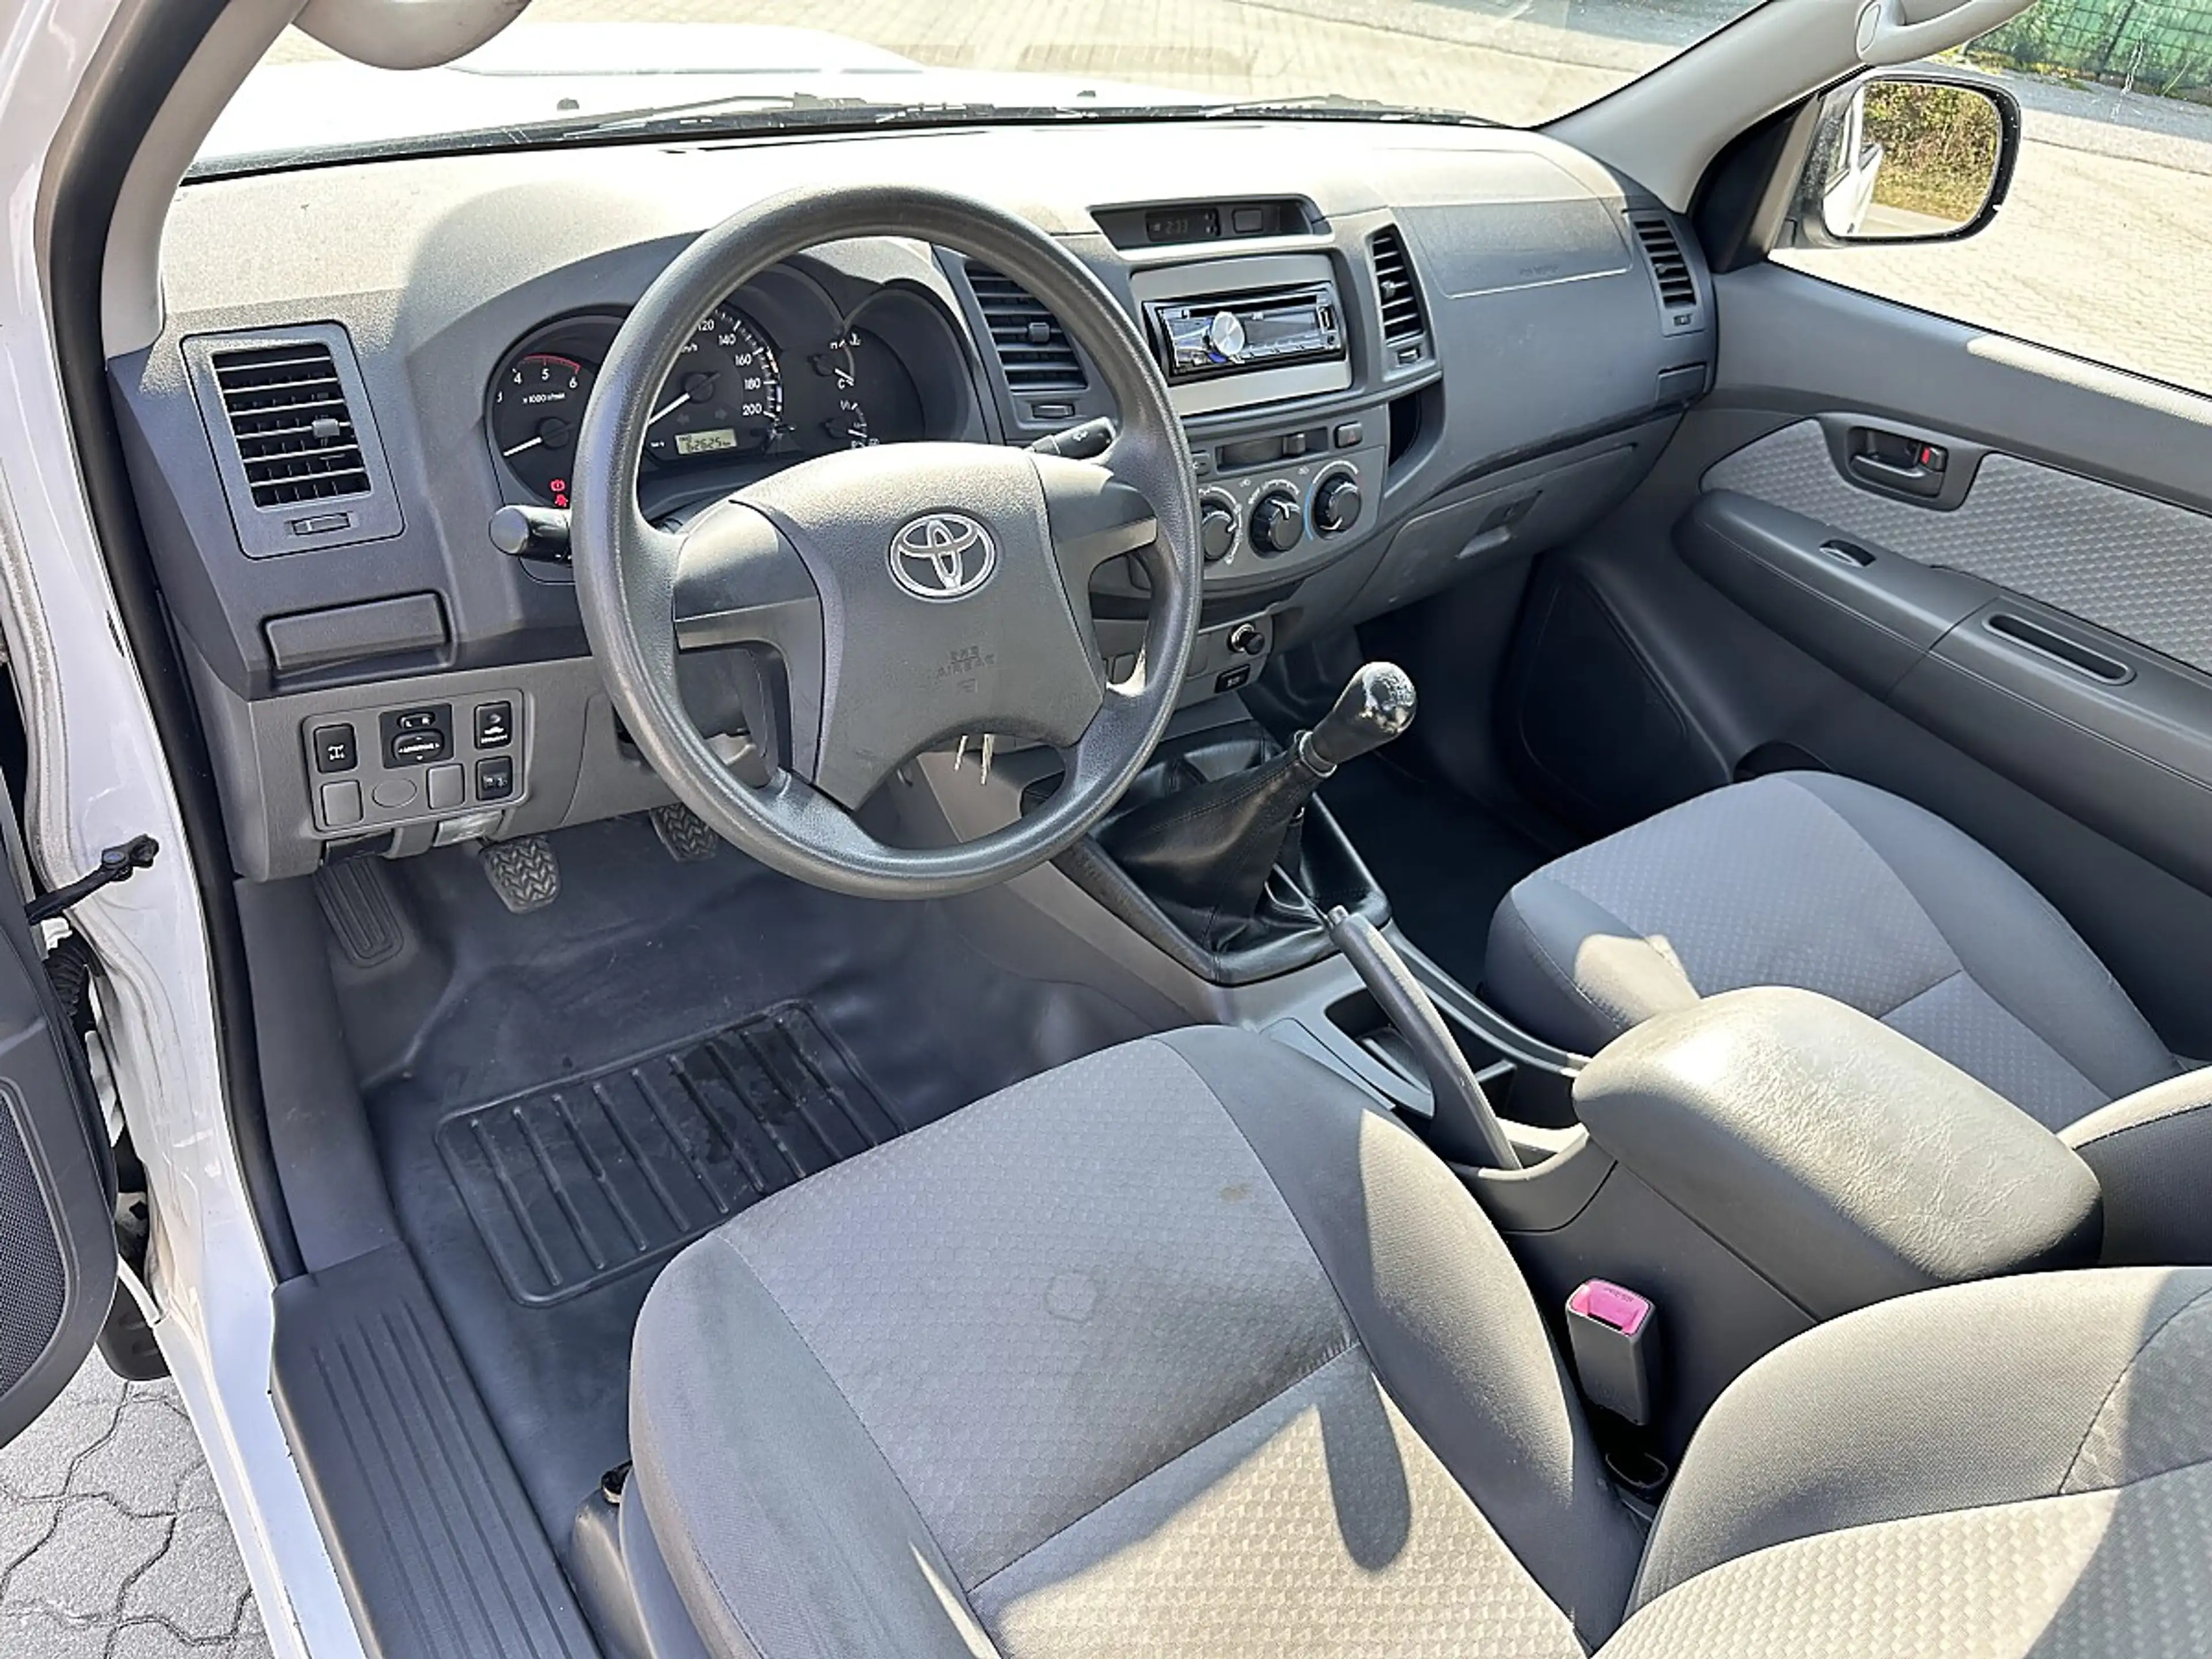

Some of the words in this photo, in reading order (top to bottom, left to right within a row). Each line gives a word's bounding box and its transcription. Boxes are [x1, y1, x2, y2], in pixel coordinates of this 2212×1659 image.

[698, 319, 714, 331] 120
[718, 333, 736, 346] 140
[735, 353, 752, 366] 160
[514, 372, 522, 384] 4
[541, 368, 550, 380] 5
[569, 376, 578, 388] 6
[744, 377, 761, 389] 180
[837, 378, 845, 390] C
[743, 403, 762, 415] 200
